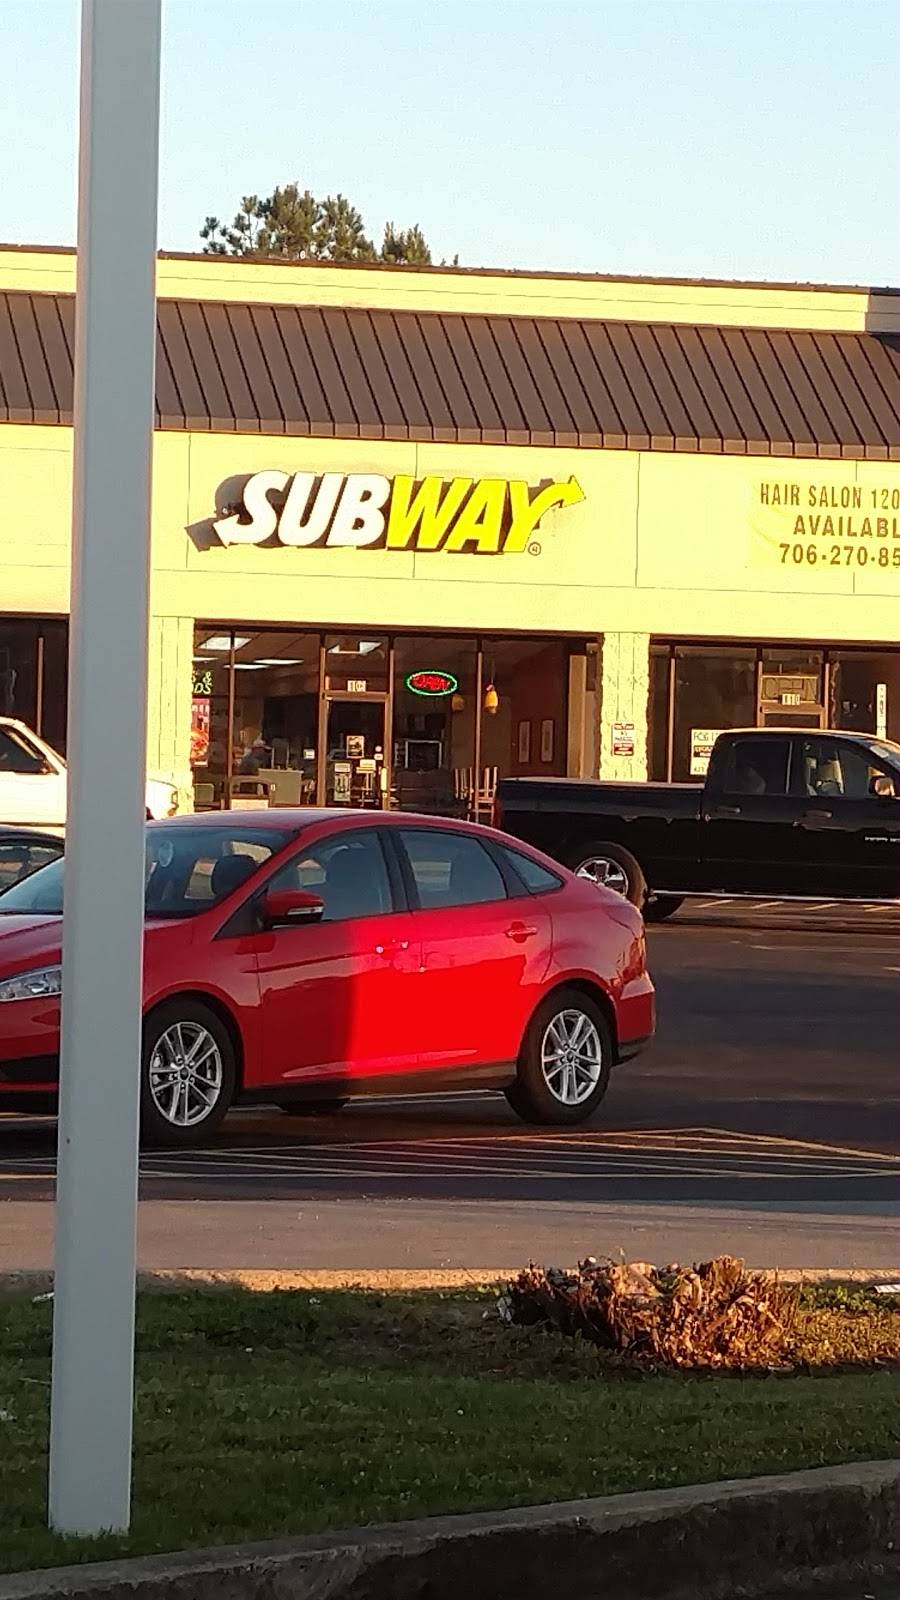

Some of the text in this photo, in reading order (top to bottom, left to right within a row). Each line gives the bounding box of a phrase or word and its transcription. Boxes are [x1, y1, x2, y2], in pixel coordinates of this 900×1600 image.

[760, 483, 800, 506] HAIR
[808, 485, 861, 508] SALON
[213, 469, 586, 554] SUBWAY
[793, 514, 900, 539] AVAILABL
